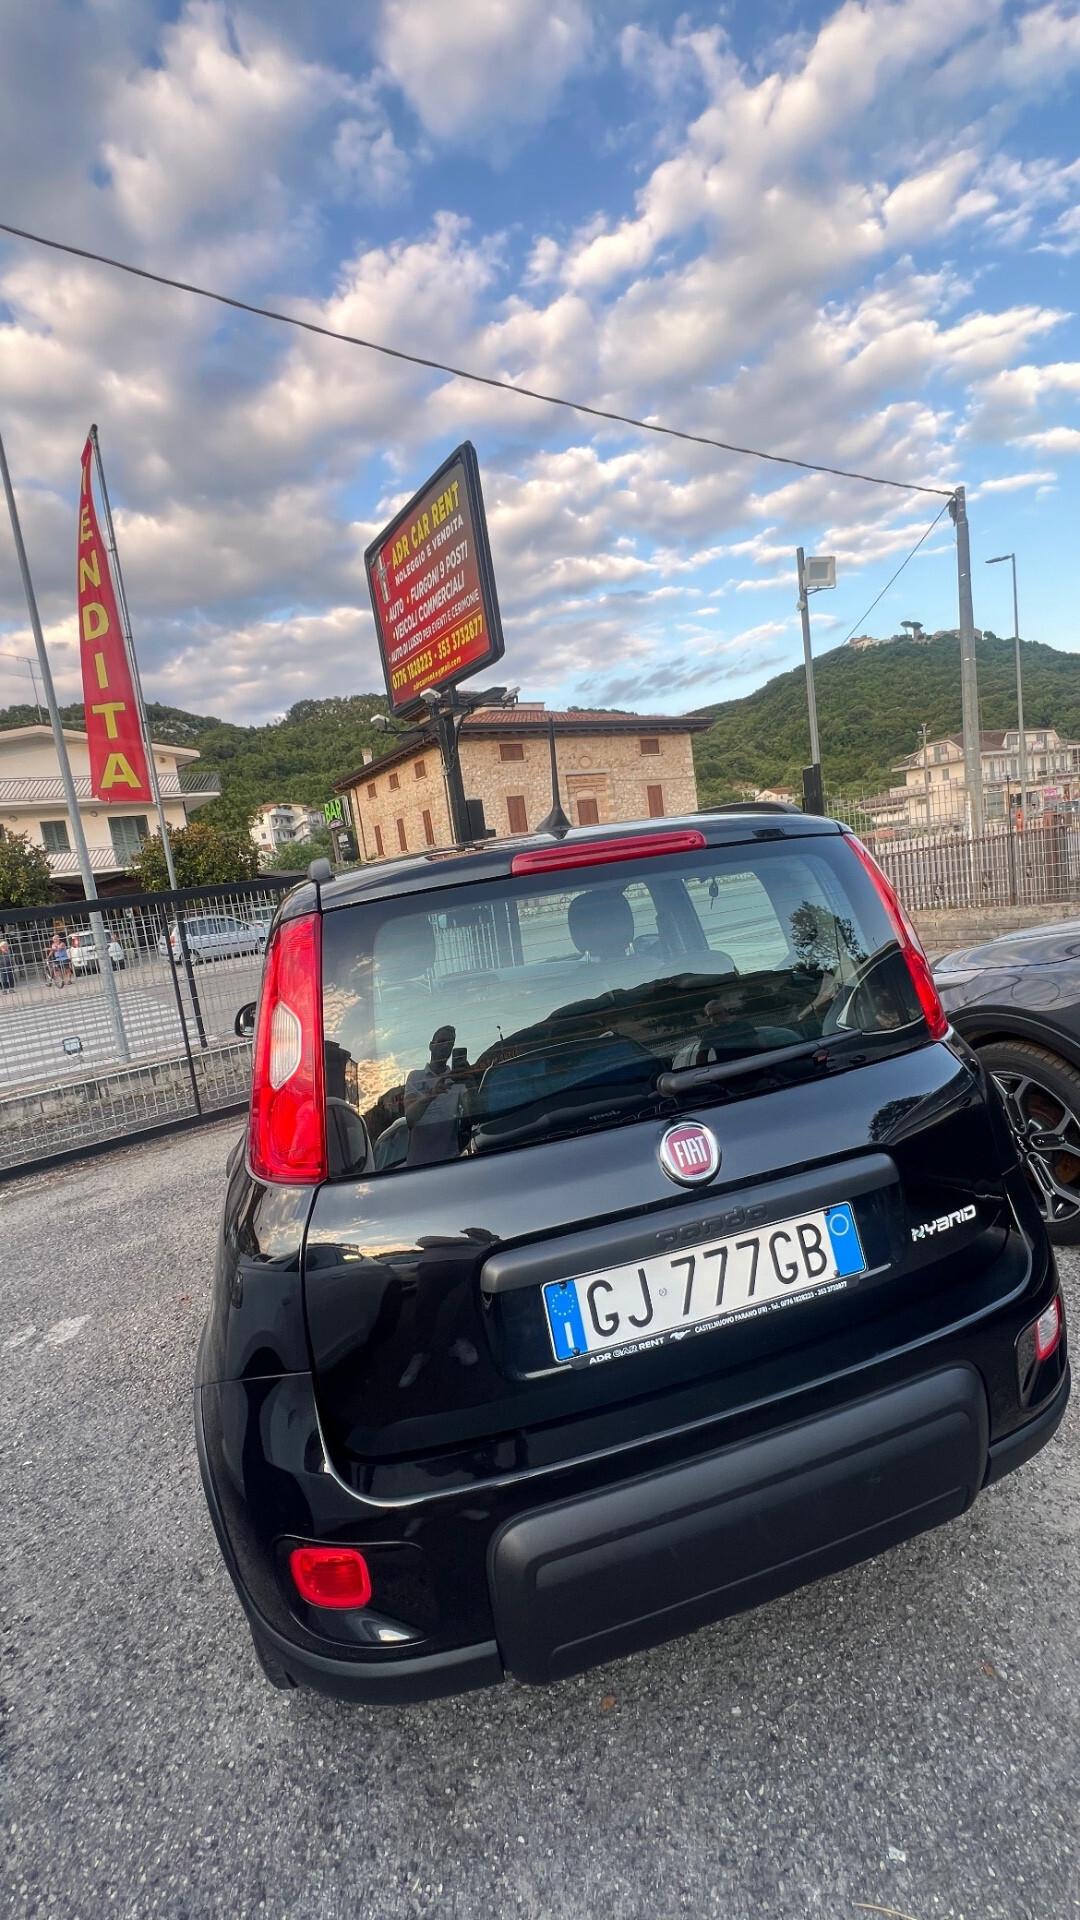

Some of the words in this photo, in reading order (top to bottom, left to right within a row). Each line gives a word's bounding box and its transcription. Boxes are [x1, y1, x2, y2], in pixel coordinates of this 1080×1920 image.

[392, 535, 410, 569] ADR
[411, 512, 430, 549] CAR
[431, 480, 459, 528] RENT
[395, 550, 426, 586] NOLEGGIO
[426, 544, 432, 556] E
[432, 514, 464, 550] VENDITA
[390, 598, 404, 623] AUTO
[410, 566, 440, 604] FURGONI
[440, 561, 444, 578] 9
[446, 540, 468, 573] POSTI
[394, 610, 418, 640] VEICOLI
[418, 570, 464, 622] COMMERCIALI
[422, 624, 432, 640] PER
[432, 612, 448, 634] EVENTI
[451, 588, 480, 618] CERIMONIE
[438, 637, 451, 660] 353
[451, 614, 482, 651] 3732877
[324, 799, 343, 825] BAR
[673, 1136, 708, 1168] FIAT
[911, 1204, 976, 1242] HYBRID
[694, 1316, 734, 1334] CASTELNUOVO
[734, 1308, 758, 1321] PARANO
[589, 1352, 612, 1365] ADR
[612, 1344, 639, 1358] CAR
[638, 1337, 665, 1350] RENT
